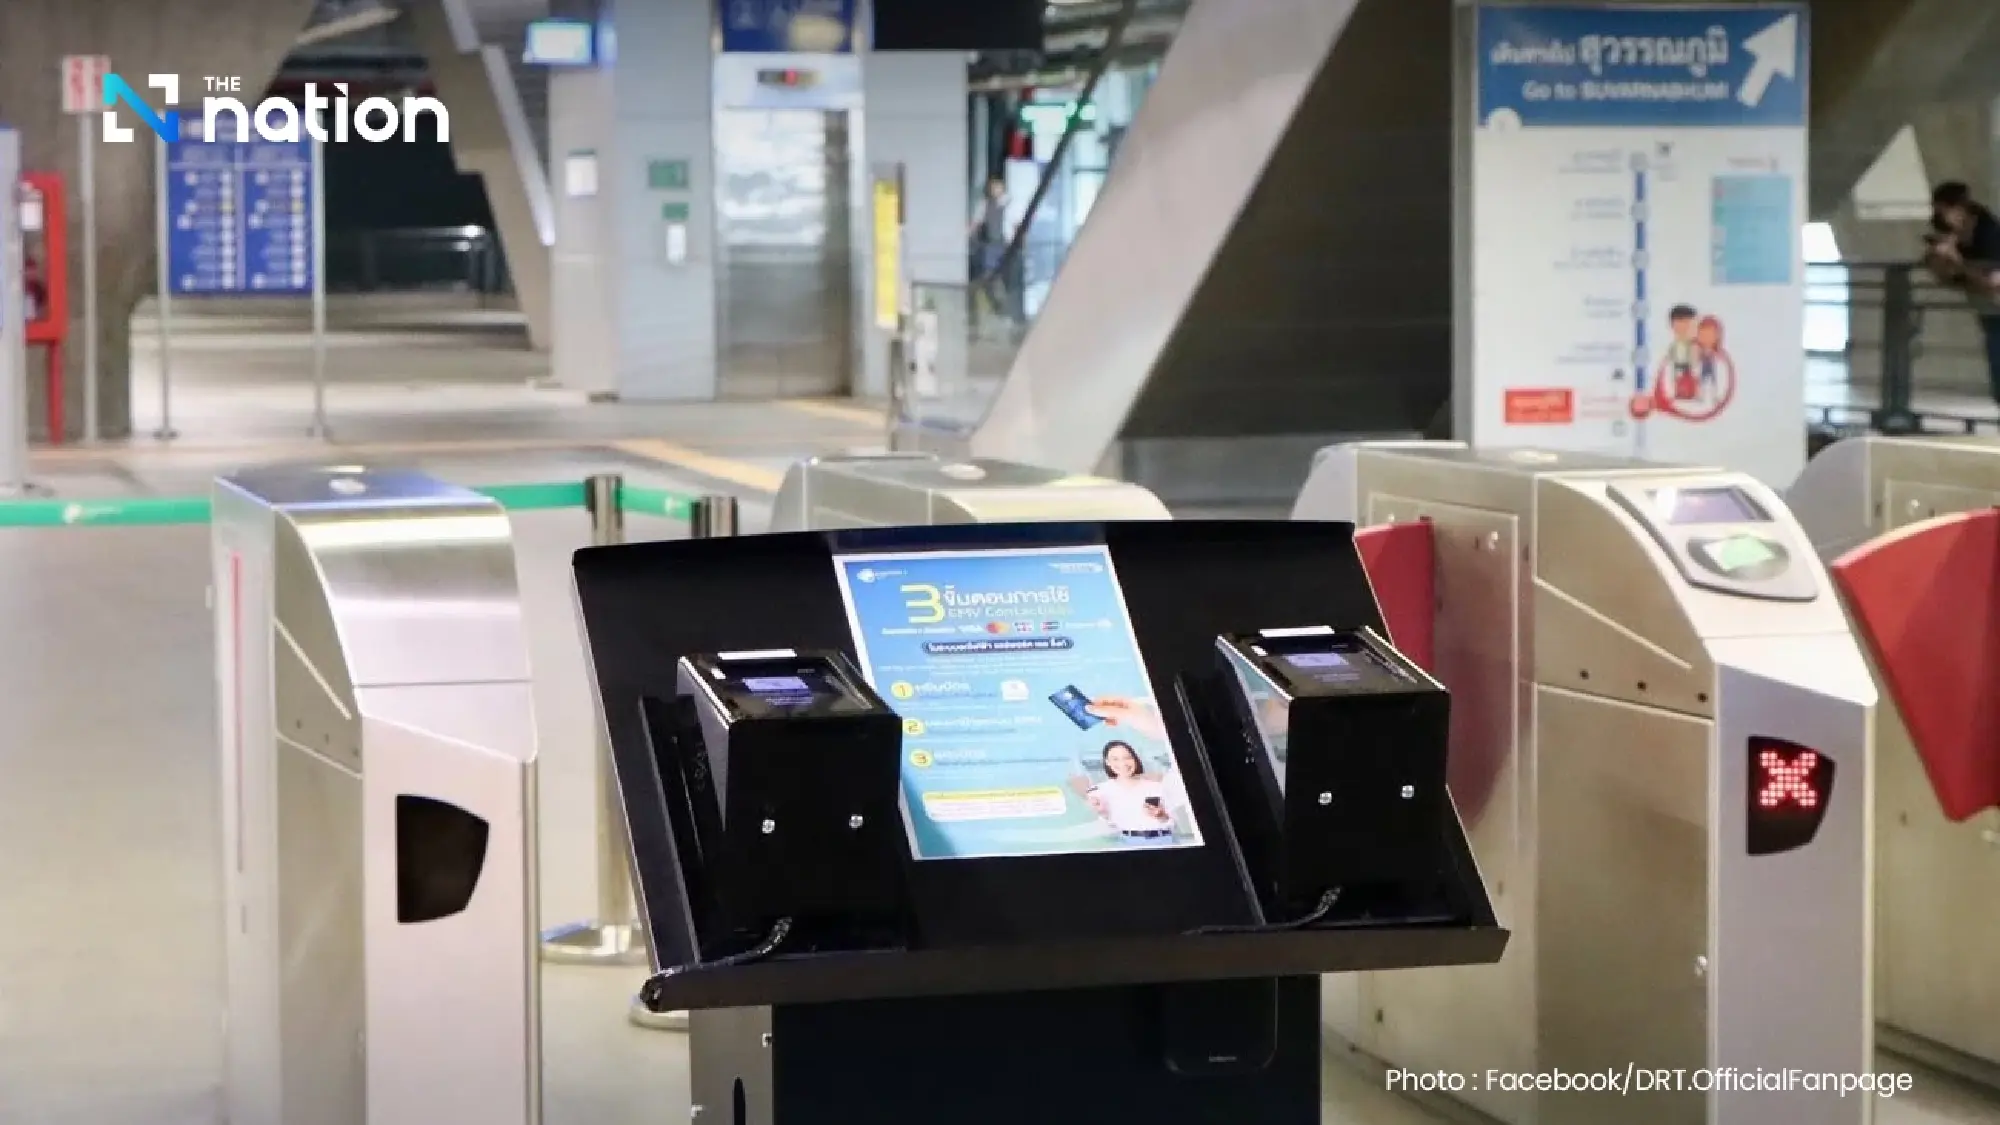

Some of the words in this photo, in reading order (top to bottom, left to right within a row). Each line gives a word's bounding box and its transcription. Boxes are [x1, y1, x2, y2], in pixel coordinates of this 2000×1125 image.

[1579, 25, 1729, 77] สุวรรณภูมิ
[1522, 79, 1551, 101] Go
[1554, 81, 1577, 100] to
[901, 584, 946, 624] 3
